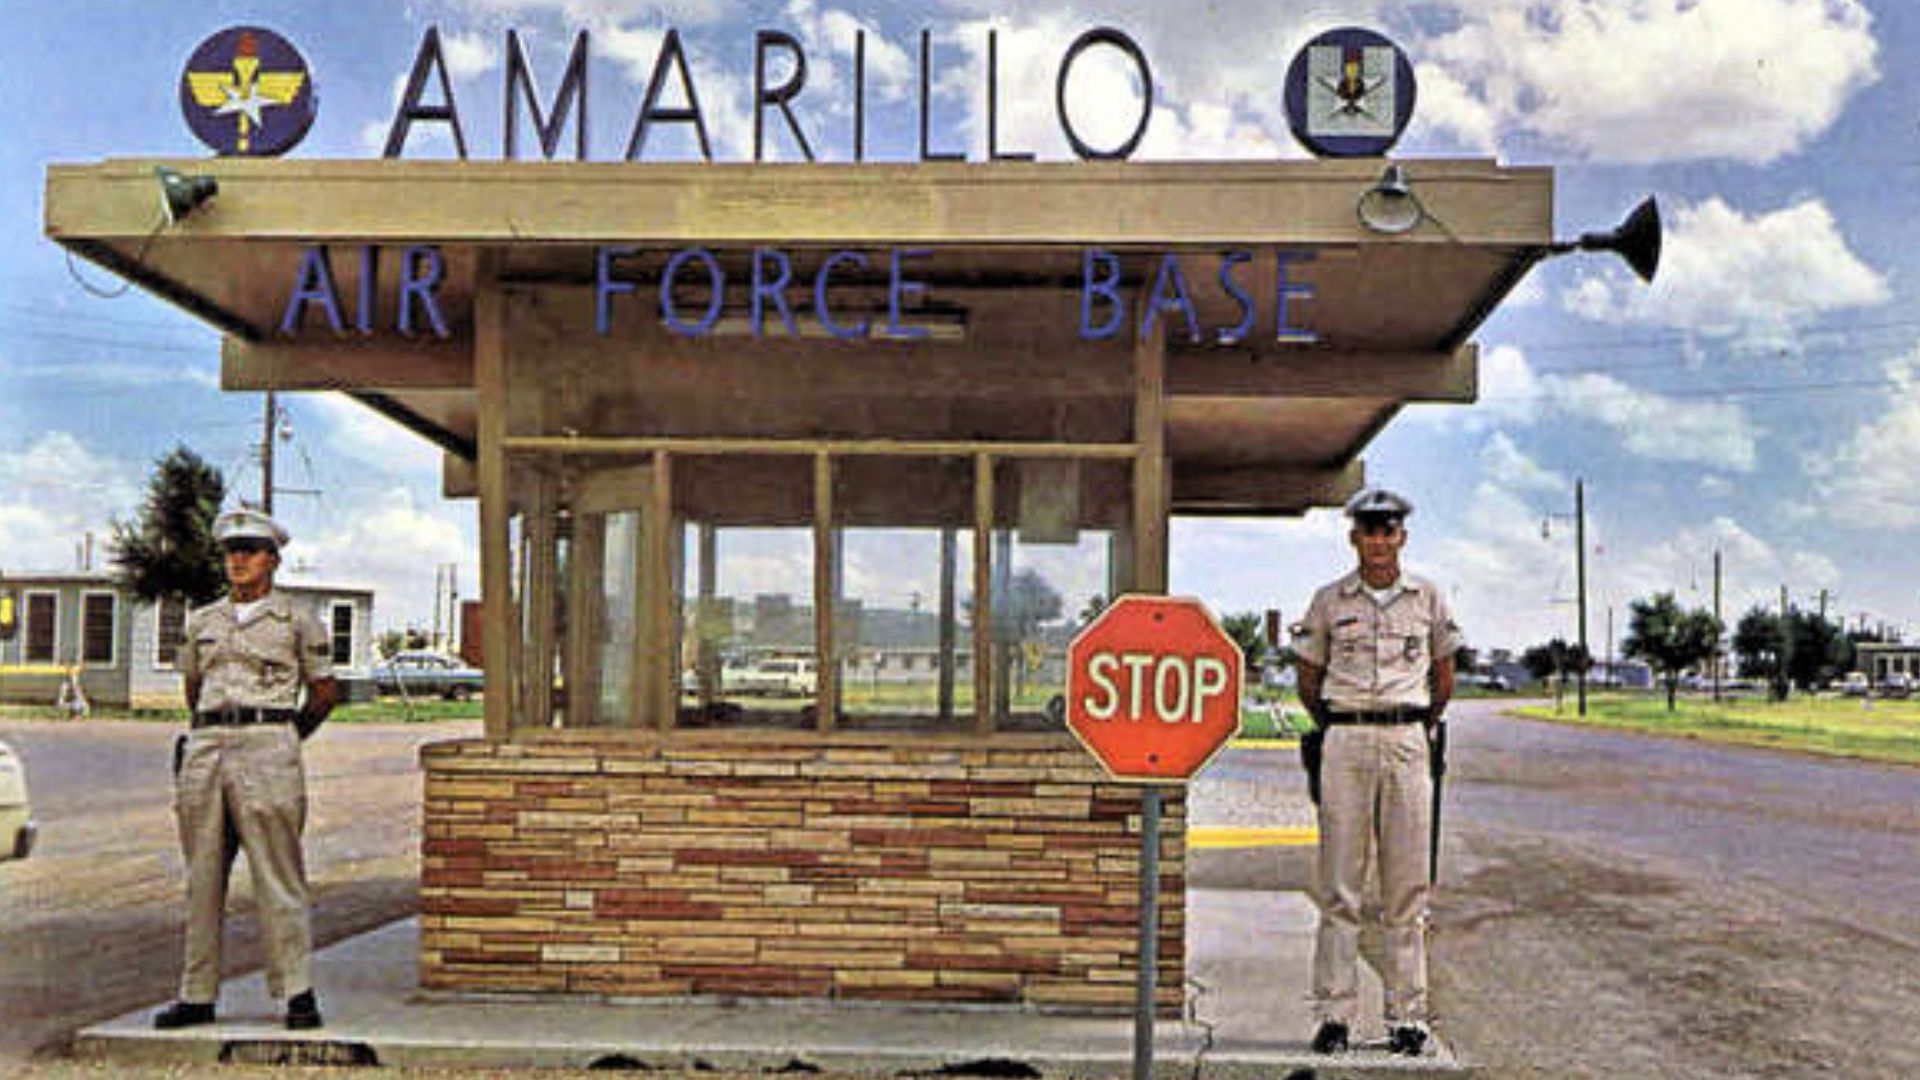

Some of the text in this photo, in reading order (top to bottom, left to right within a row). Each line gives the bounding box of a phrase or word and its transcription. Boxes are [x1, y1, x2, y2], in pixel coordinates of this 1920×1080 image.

[384, 26, 1154, 161] AMARILLO
[282, 247, 1320, 344] AIR FORCE BASE
[1084, 653, 1228, 723] STOP
